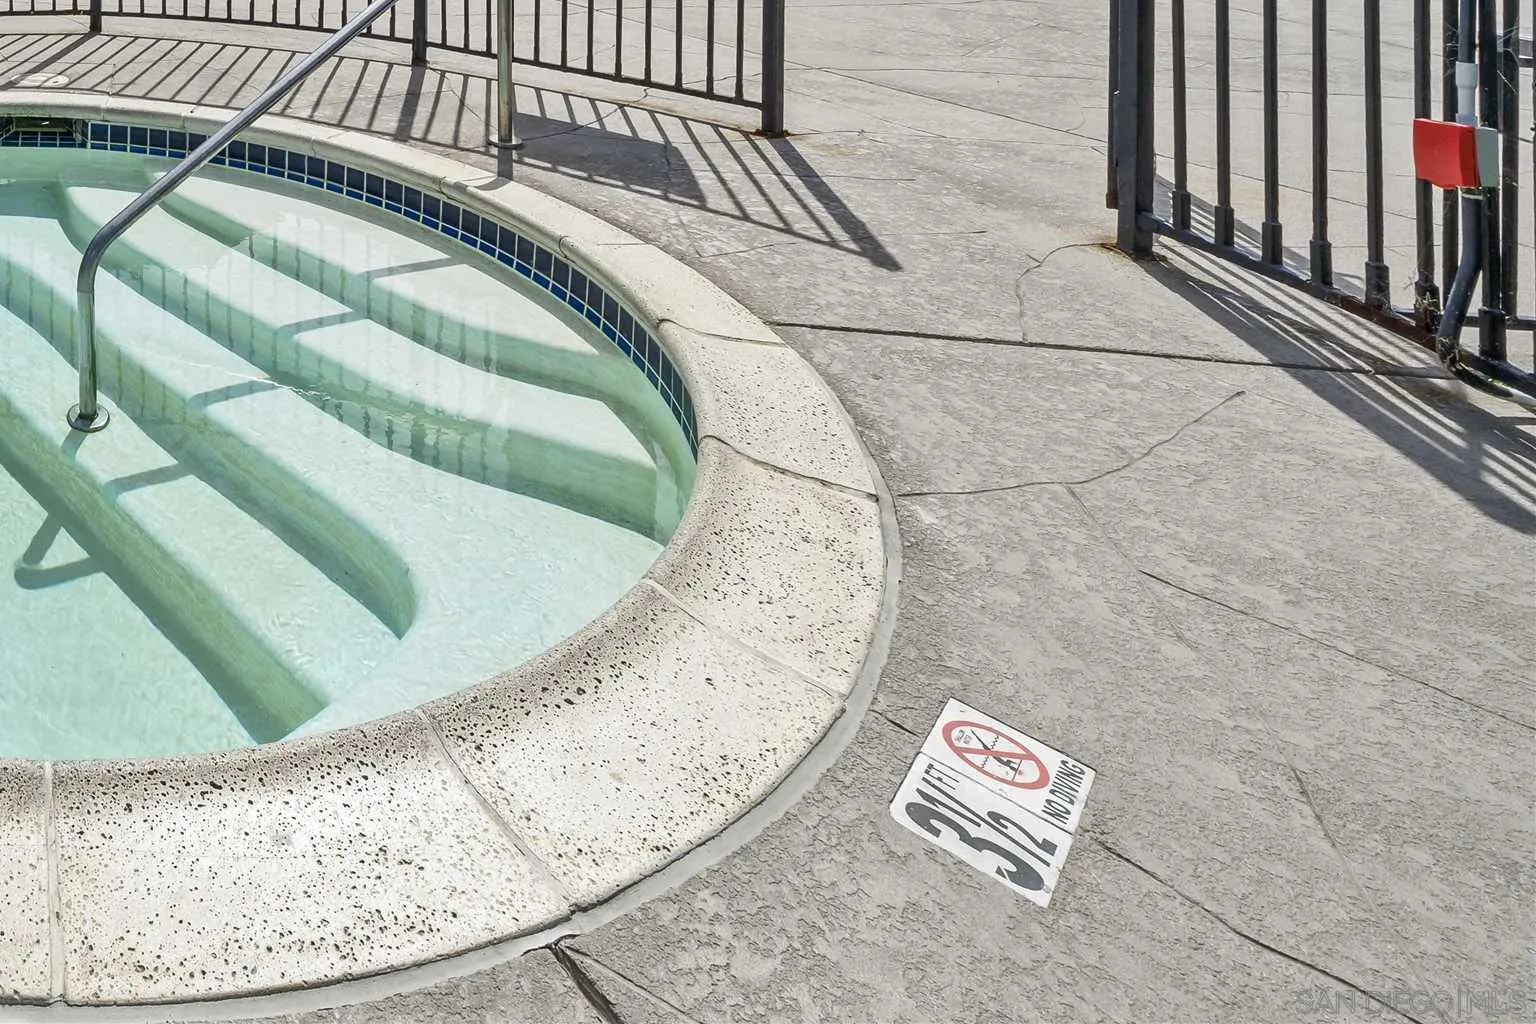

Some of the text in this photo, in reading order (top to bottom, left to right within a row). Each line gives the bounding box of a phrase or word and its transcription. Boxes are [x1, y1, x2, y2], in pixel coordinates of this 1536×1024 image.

[924, 763, 960, 791] FT
[1041, 759, 1086, 825] NO DIVING
